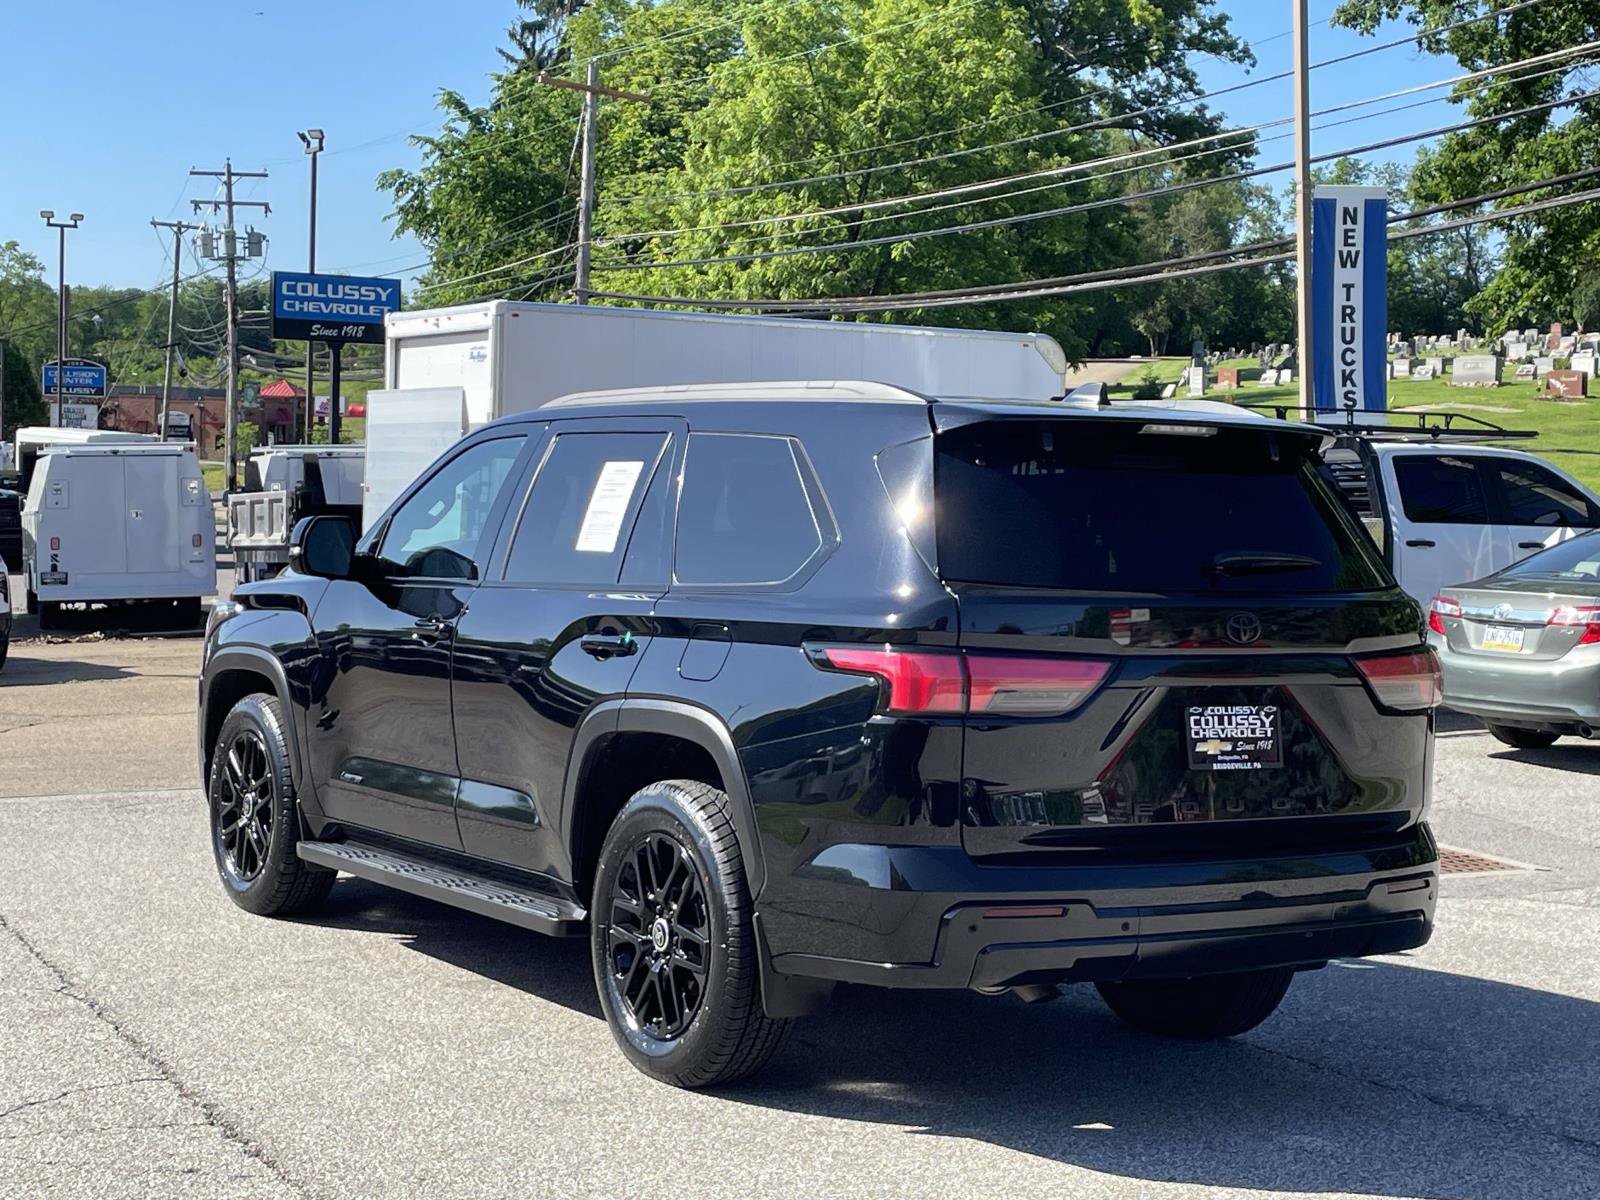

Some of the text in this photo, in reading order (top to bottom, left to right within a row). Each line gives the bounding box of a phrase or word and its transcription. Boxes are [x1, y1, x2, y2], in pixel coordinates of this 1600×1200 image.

[1338, 206, 1360, 269] NEW
[281, 280, 393, 302] COLUSSY
[283, 300, 393, 316] CHEVROLET
[310, 324, 366, 337] Since 1918
[1340, 283, 1357, 410] TRUCKS
[48, 370, 99, 378] COLISION
[1207, 706, 1259, 715] COLUSSY
[1190, 715, 1275, 729] COLUSSY
[1191, 727, 1275, 739] CHEVROLET
